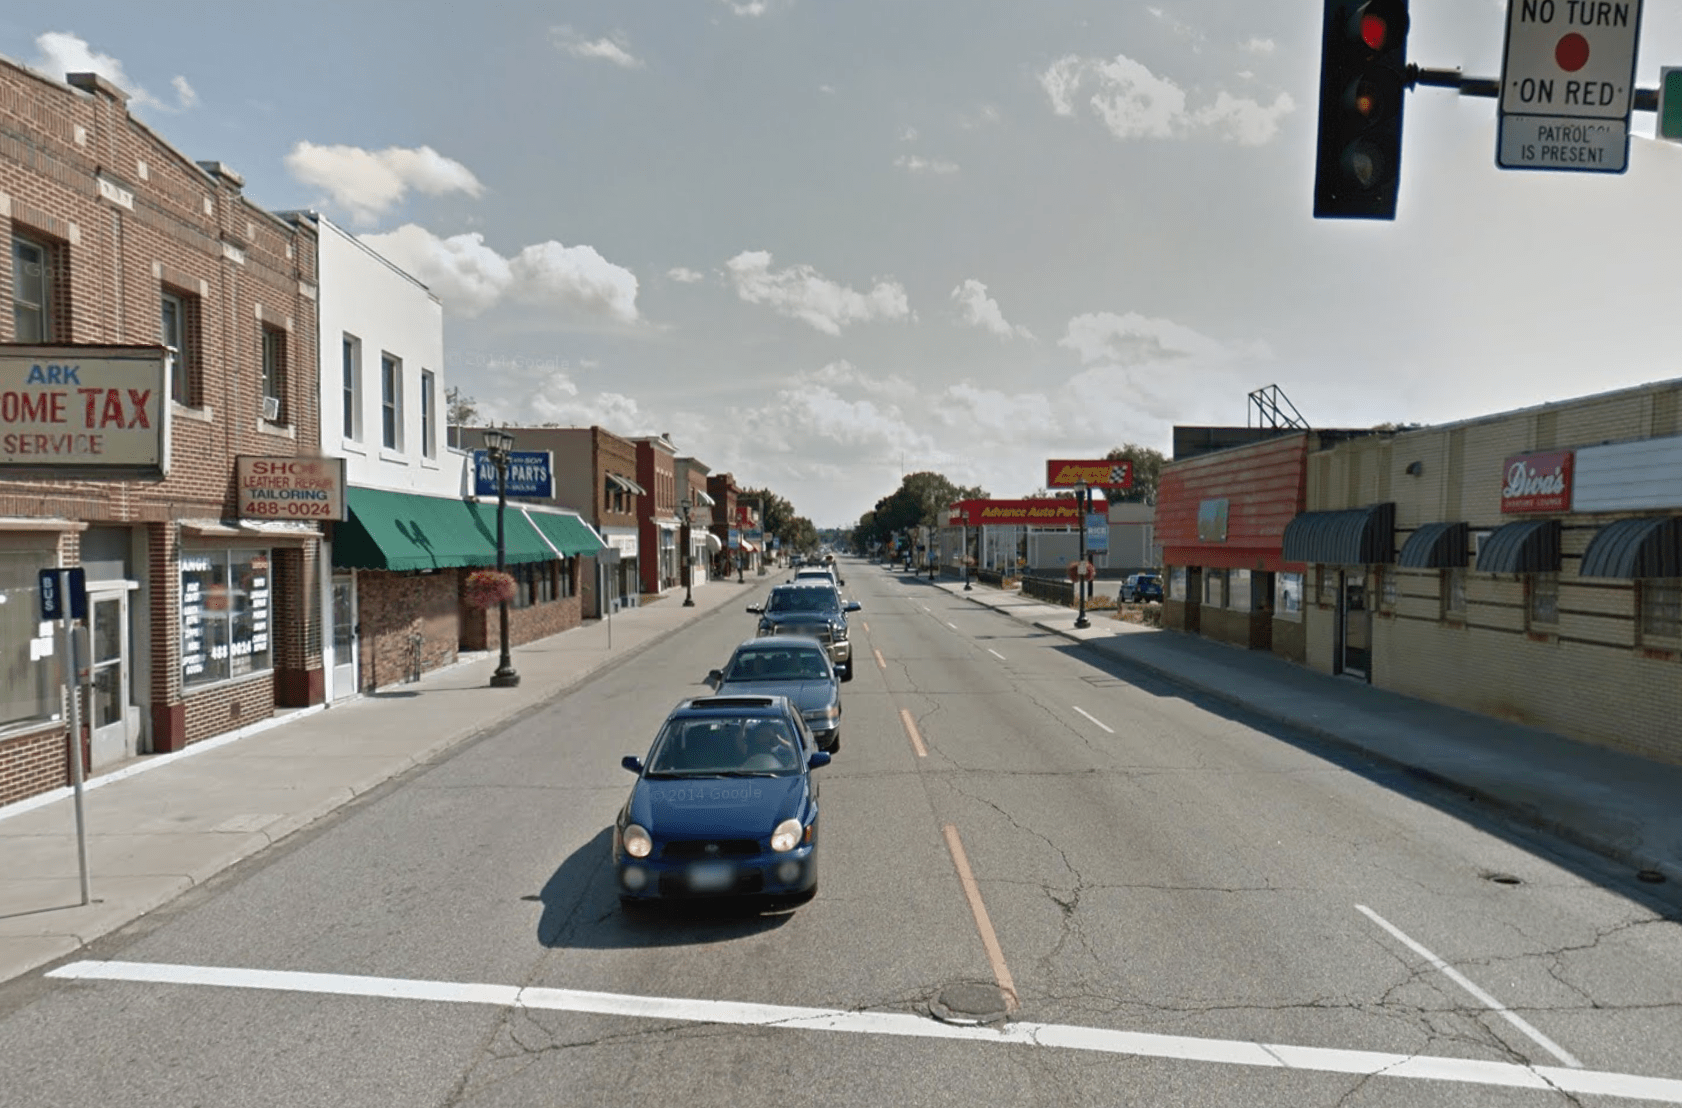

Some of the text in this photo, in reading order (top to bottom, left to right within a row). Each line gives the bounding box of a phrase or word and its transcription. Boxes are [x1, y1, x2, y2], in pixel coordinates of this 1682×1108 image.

[1521, 0, 1629, 28] NO TURN
[1520, 77, 1615, 107] ON RED
[1538, 125, 1591, 144] PATROL
[1521, 144, 1604, 164] IS PRESENT
[26, 363, 81, 385] ARK
[77, 387, 151, 429] TAX
[4, 432, 104, 455] SERVICE
[243, 475, 290, 488] LEATHER
[511, 464, 547, 482] PARTS
[251, 489, 329, 500] TAILORING
[245, 501, 331, 516] 488-0024
[1028, 506, 1055, 518] Auto
[42, 576, 54, 612] BUS
